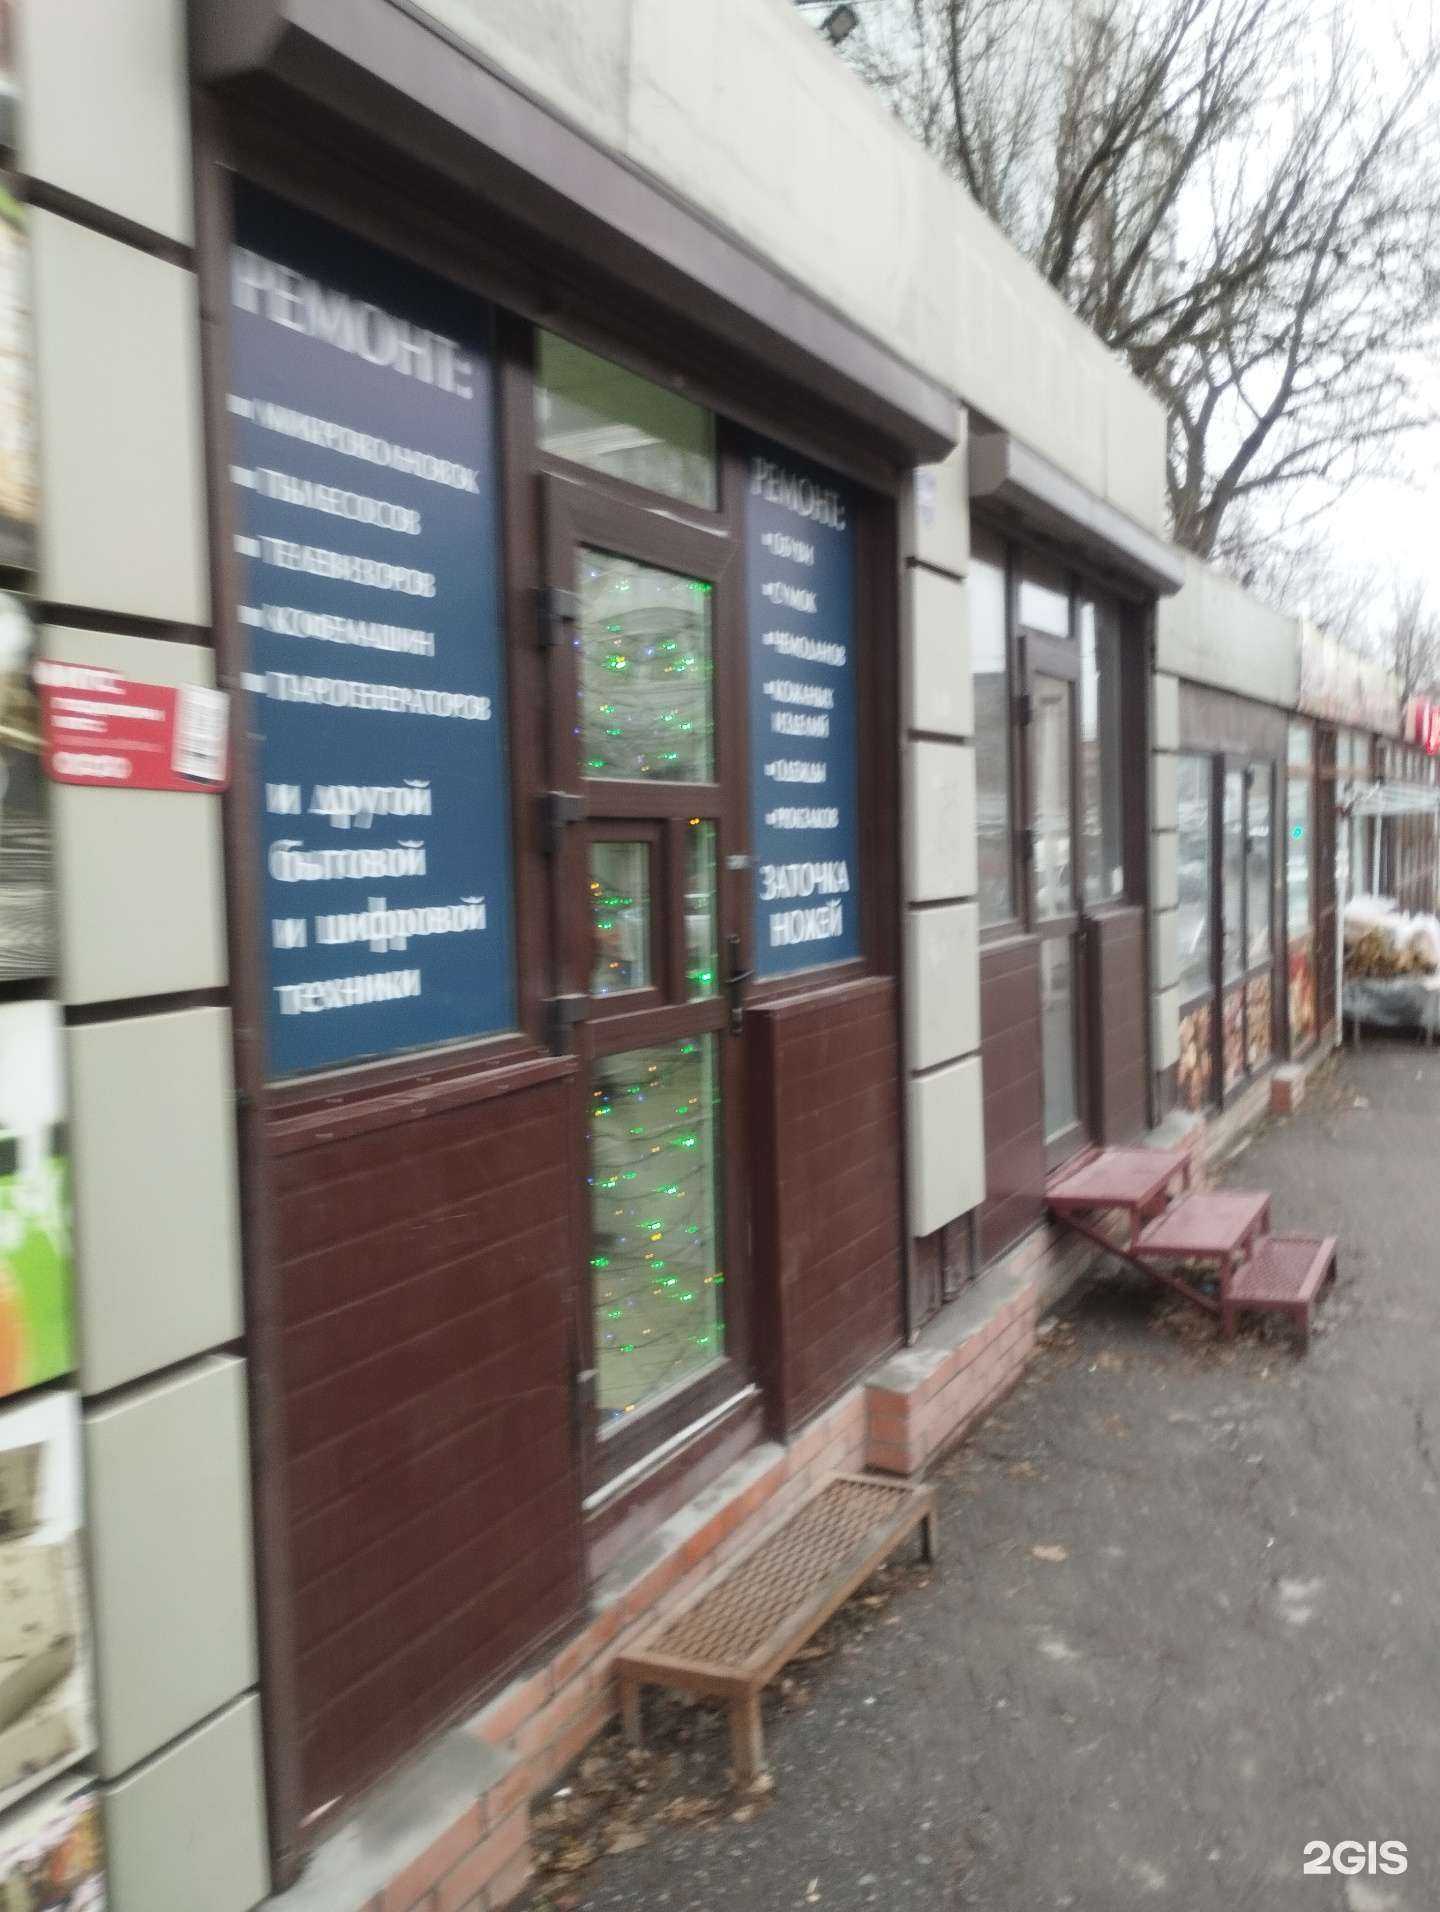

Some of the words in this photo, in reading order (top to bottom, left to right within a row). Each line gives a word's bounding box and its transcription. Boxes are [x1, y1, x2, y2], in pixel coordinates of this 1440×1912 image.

[232, 243, 473, 400] РЕМОНТ:
[256, 467, 422, 535] ПЫЛЕСОСОВ
[751, 457, 846, 531] РЕМОНТ:
[259, 535, 437, 598] ТЕЛЕВИЗОРОВ
[263, 603, 435, 657] КОФЕМАШИН
[265, 783, 302, 815] и
[308, 779, 432, 829] другой
[268, 839, 426, 883] бытовой
[759, 860, 850, 901] ЗАТОЧКА
[272, 918, 307, 949] и
[315, 896, 487, 953] цифровой
[769, 897, 843, 947] НОЖЕЙ
[273, 968, 422, 1015] техники
